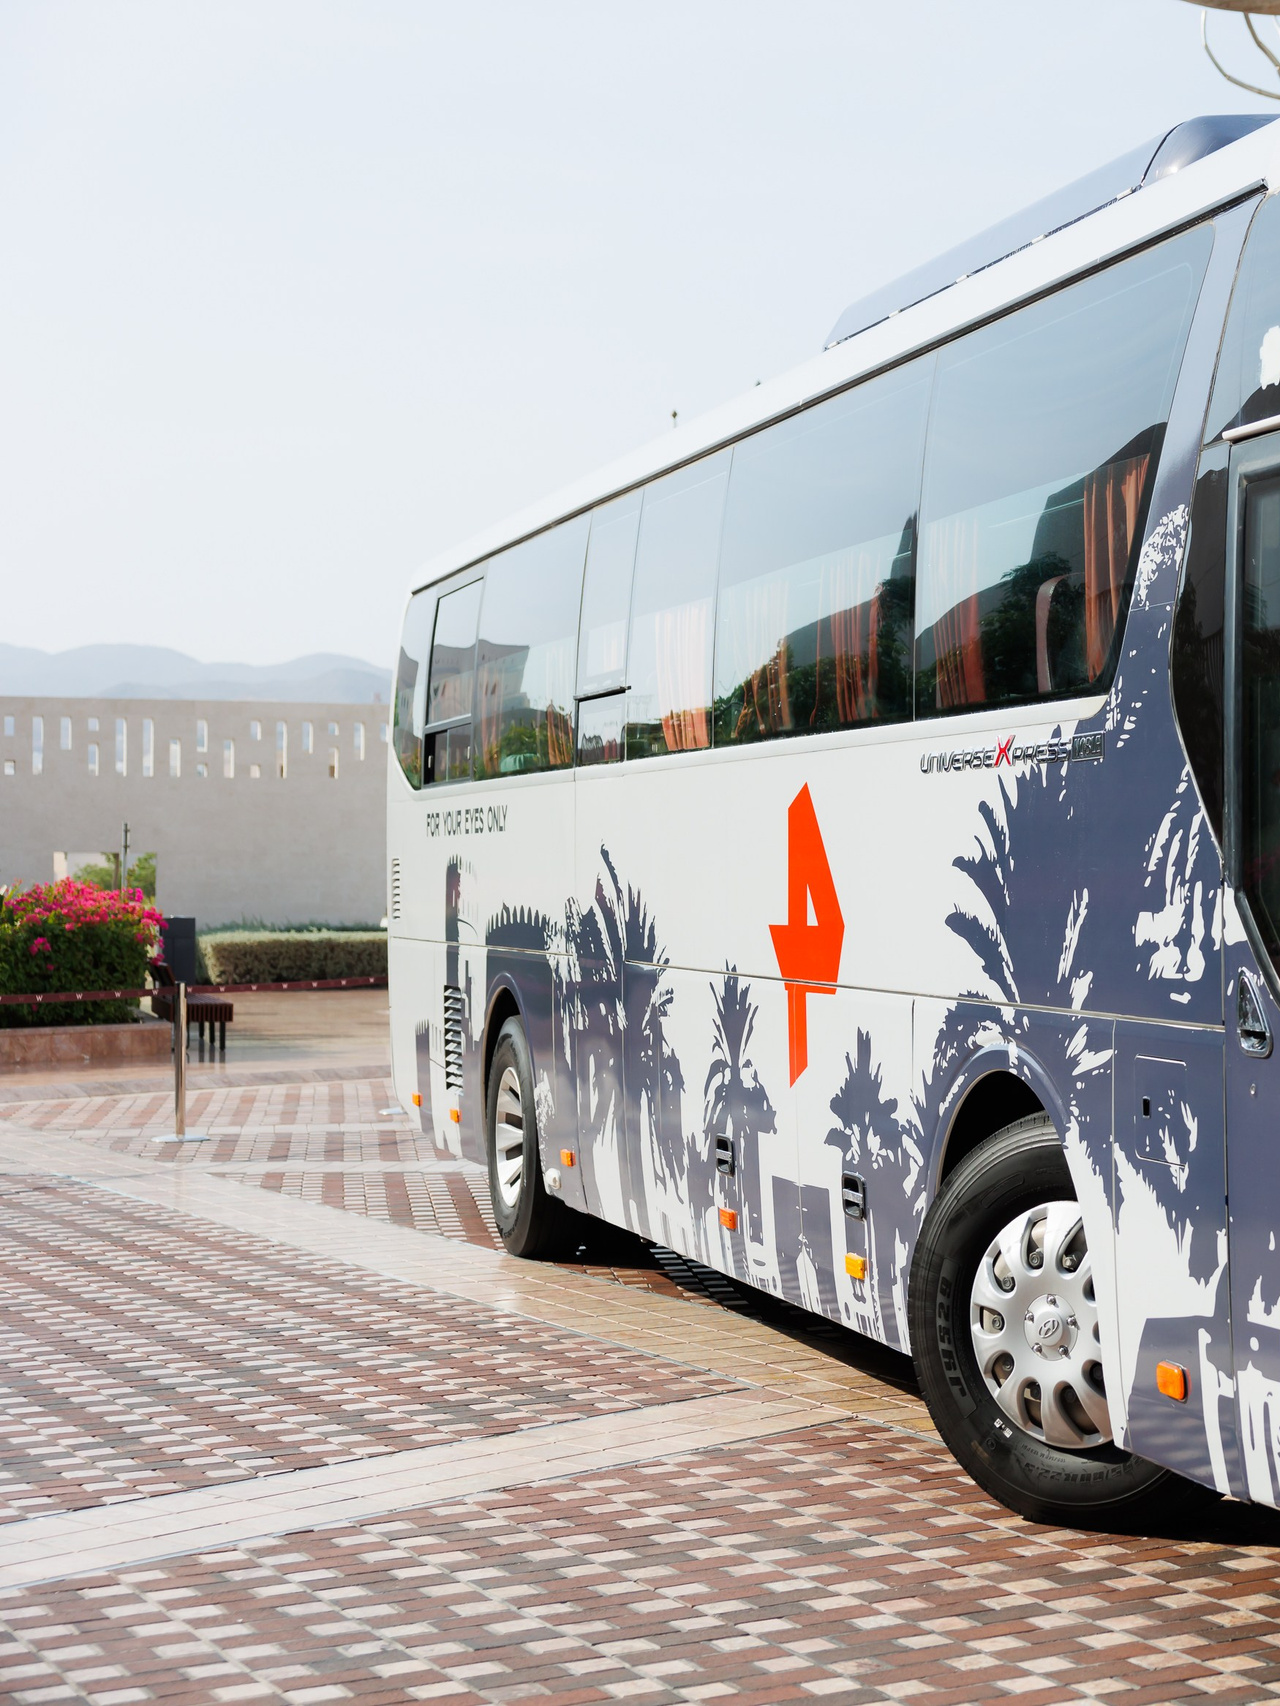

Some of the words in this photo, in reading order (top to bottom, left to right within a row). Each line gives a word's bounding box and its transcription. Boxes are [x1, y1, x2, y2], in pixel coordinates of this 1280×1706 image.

[426, 812, 440, 837] FOR
[442, 809, 462, 837] YOUR
[465, 807, 485, 835] EYES
[487, 804, 508, 833] ONLY
